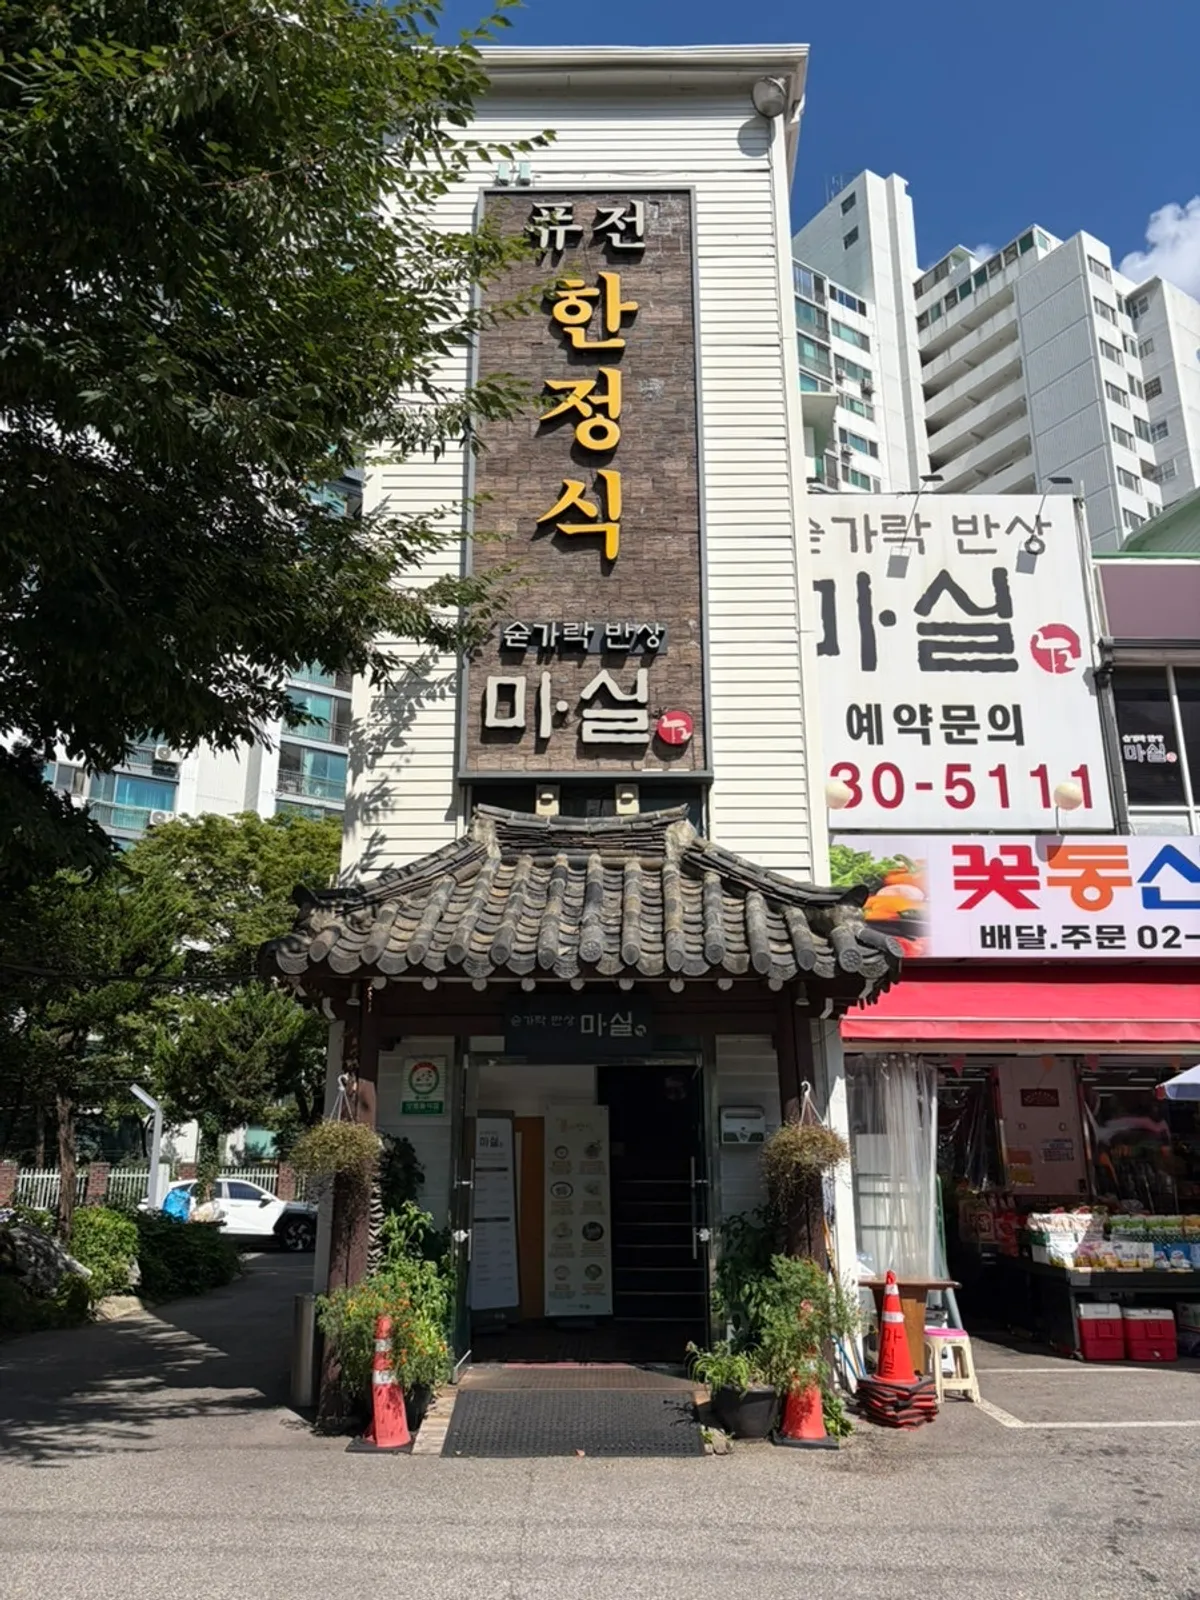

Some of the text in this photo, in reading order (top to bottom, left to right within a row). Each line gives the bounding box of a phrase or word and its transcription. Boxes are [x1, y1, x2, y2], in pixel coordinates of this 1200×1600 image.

[527, 201, 646, 250] 퓨전
[536, 271, 639, 561] 한정식
[952, 513, 1052, 556] 반상
[503, 621, 664, 649] 숟가락 반상
[845, 703, 1025, 746] 예약문의
[829, 762, 1094, 810] 30-5111
[980, 924, 1127, 950] 배달.주문
